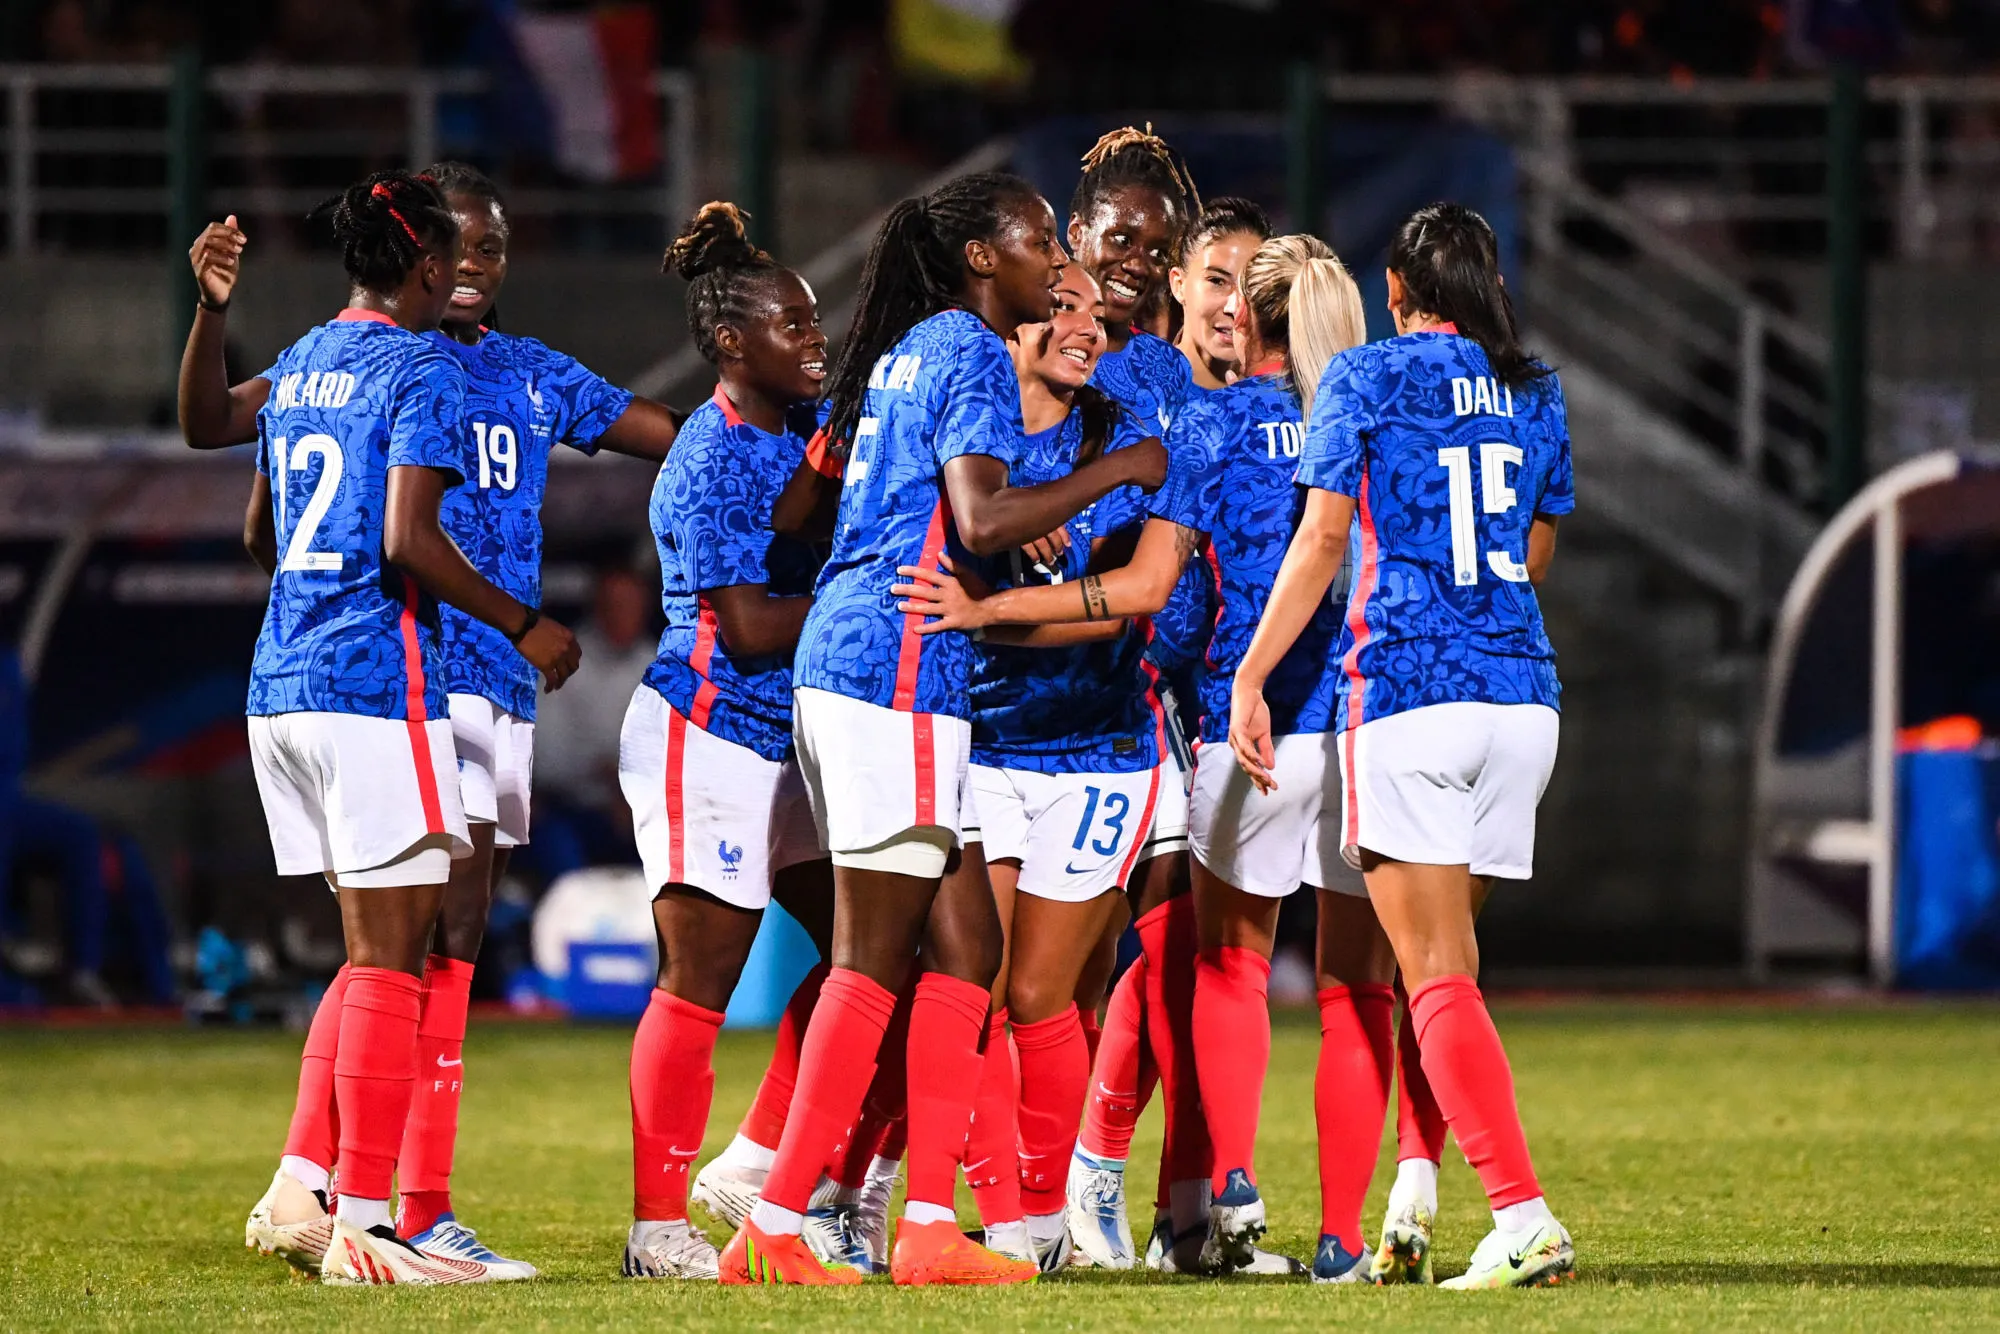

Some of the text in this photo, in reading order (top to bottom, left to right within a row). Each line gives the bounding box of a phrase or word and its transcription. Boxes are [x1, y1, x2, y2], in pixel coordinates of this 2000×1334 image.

[1451, 376, 1514, 418] DALI
[472, 421, 517, 491] 19
[273, 433, 343, 574] 12
[1437, 442, 1530, 587] 15
[1071, 785, 1131, 857] 13
